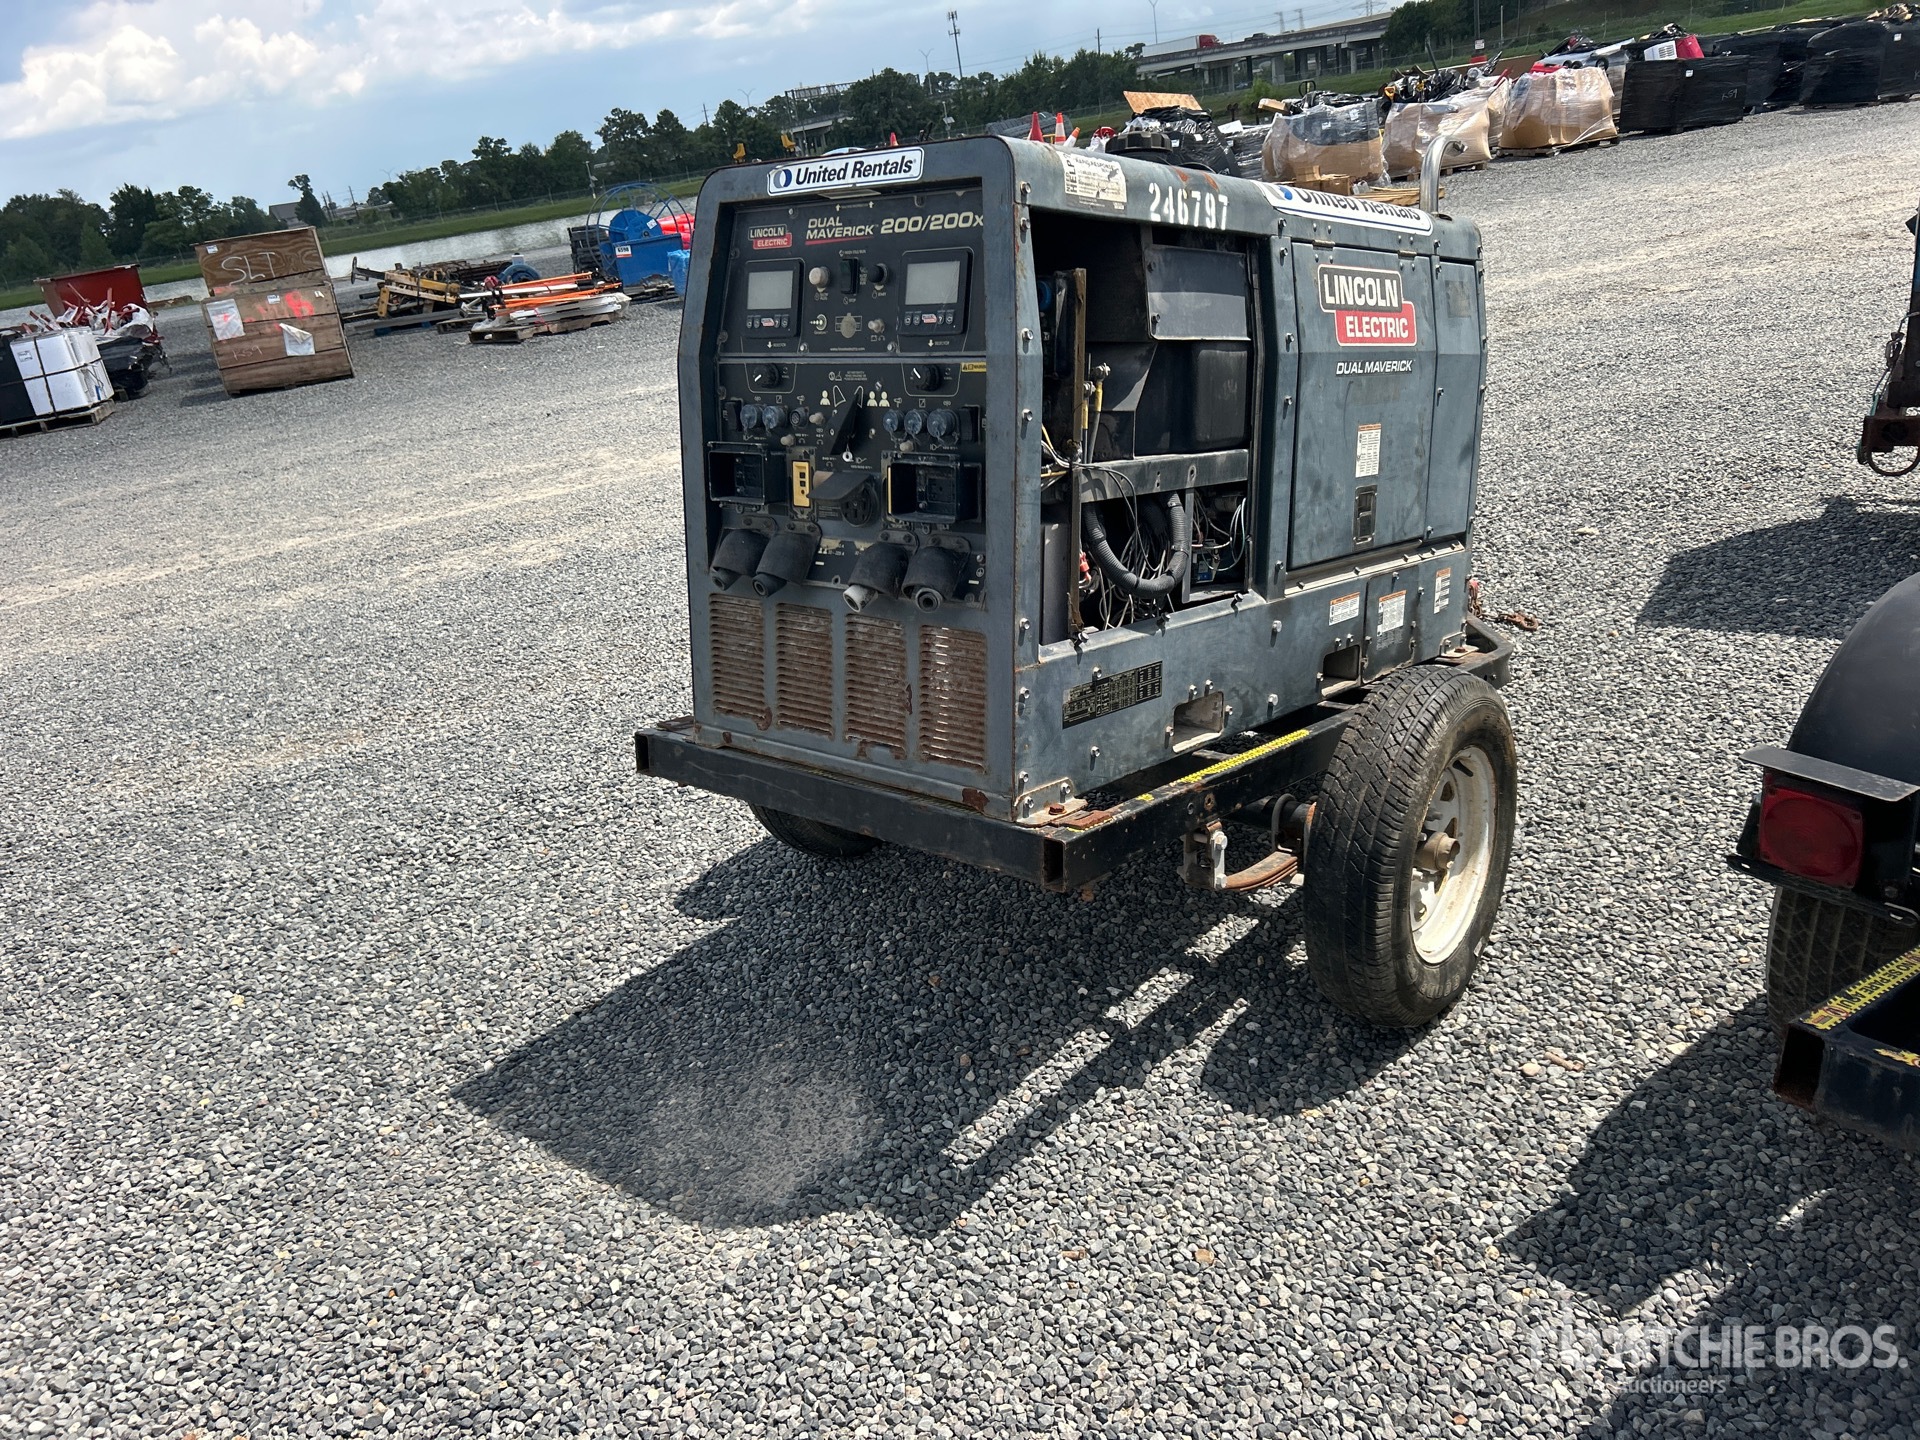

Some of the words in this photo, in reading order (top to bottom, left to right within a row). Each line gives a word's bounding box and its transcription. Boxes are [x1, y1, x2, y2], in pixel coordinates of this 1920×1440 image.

[796, 162, 849, 186] United
[851, 155, 914, 180] Rentals
[1148, 182, 1229, 231] 246797
[807, 215, 843, 229] DUAL
[749, 226, 785, 239] LINCOLN
[806, 224, 875, 240] MAVERICK
[757, 237, 788, 247] ELECTRIC
[1323, 273, 1399, 308] LINCOLN
[1345, 315, 1409, 339] ELECTRIC
[1336, 361, 1364, 375] DUAL
[1364, 360, 1413, 373] MAVERICK
